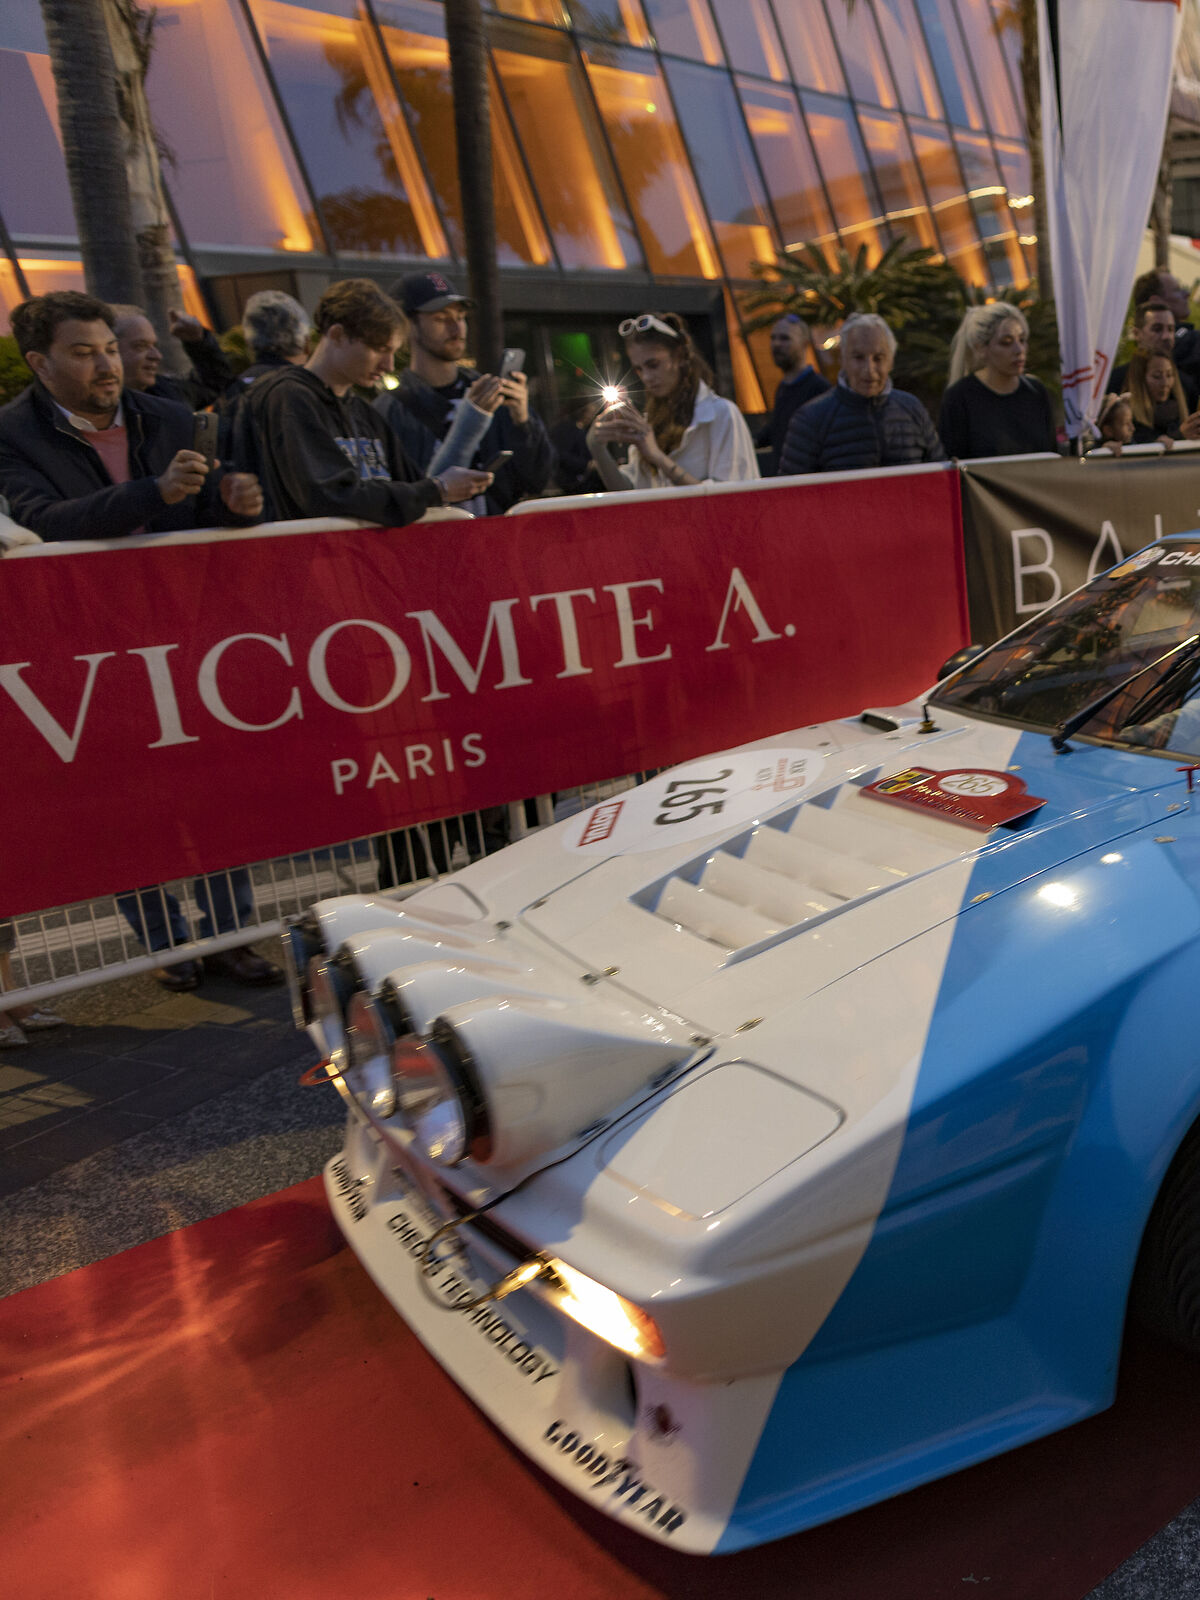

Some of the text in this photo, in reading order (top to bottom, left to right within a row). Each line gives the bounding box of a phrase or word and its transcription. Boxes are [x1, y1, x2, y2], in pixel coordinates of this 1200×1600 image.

[0, 577, 674, 764] VICOMTE
[330, 732, 488, 796] PARIS
[653, 768, 735, 826] 265
[943, 772, 998, 795] 265
[437, 1273, 560, 1384] TECHNOLOGY
[543, 1418, 689, 1537] GOODYEAR
